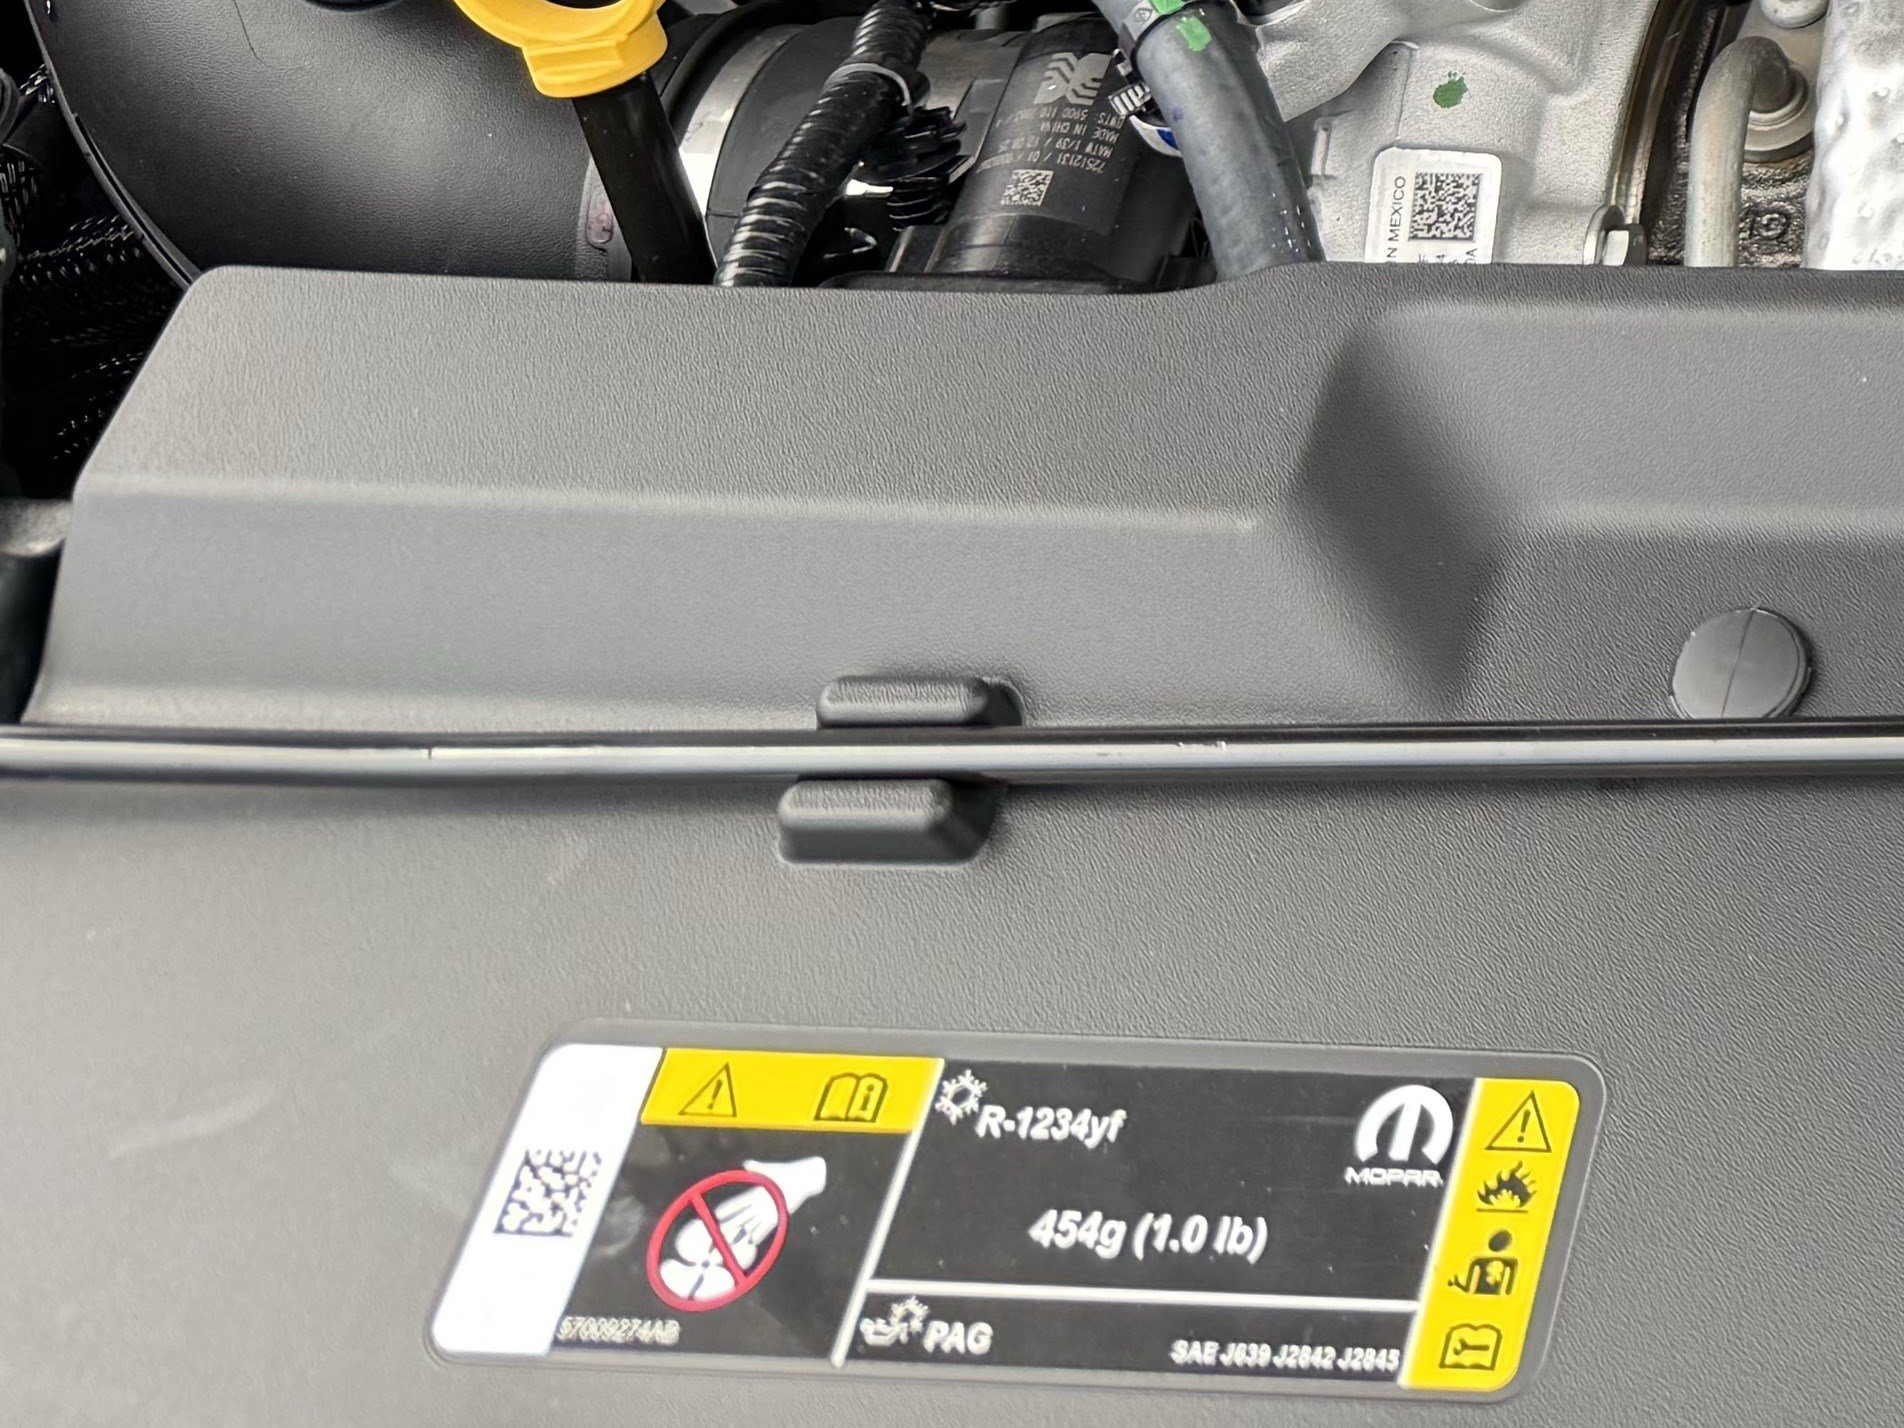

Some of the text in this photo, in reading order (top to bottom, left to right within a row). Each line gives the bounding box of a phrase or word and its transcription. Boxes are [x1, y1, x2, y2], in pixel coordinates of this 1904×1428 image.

[1388, 175, 1406, 242] MEXICO
[975, 1105, 1127, 1149] R-1234yf
[1344, 1166, 1443, 1187] MOPAR
[1028, 1209, 1267, 1264] 454g (1.0 lb)
[923, 1321, 993, 1354] PAG
[1170, 1339, 1219, 1366] SAE
